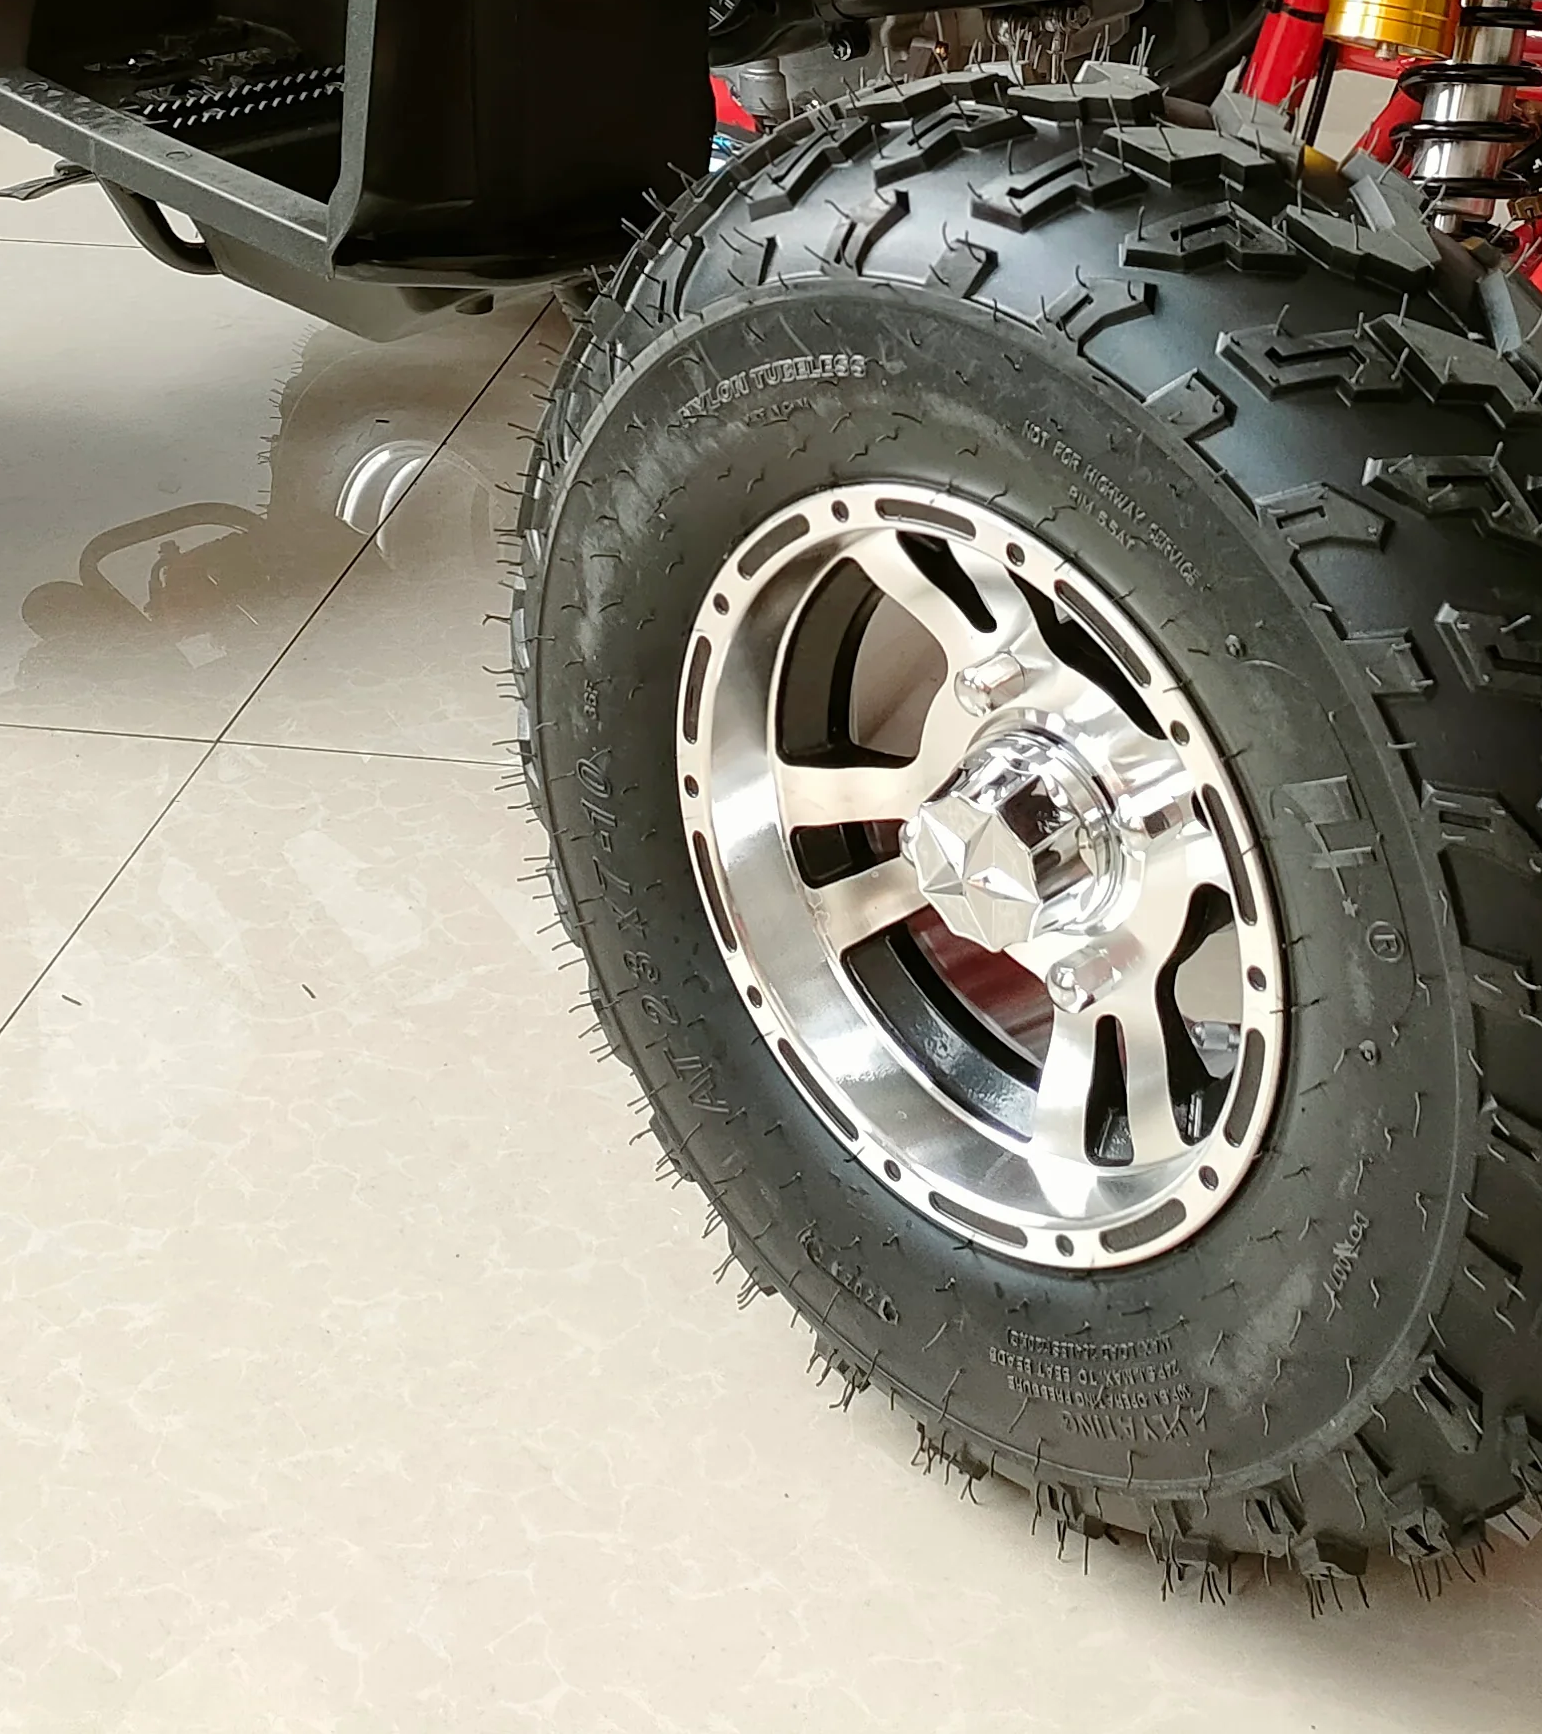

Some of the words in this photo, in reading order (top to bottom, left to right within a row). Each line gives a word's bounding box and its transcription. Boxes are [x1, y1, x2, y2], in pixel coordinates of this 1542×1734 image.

[676, 370, 750, 429] NYLON
[748, 353, 867, 390] TUBELESS
[1021, 419, 1051, 449] NOT
[1052, 440, 1083, 472] FOR
[1082, 464, 1147, 524] HIGHWAY
[1148, 521, 1203, 588] SERVICE
[1077, 1368, 1098, 1386] TO
